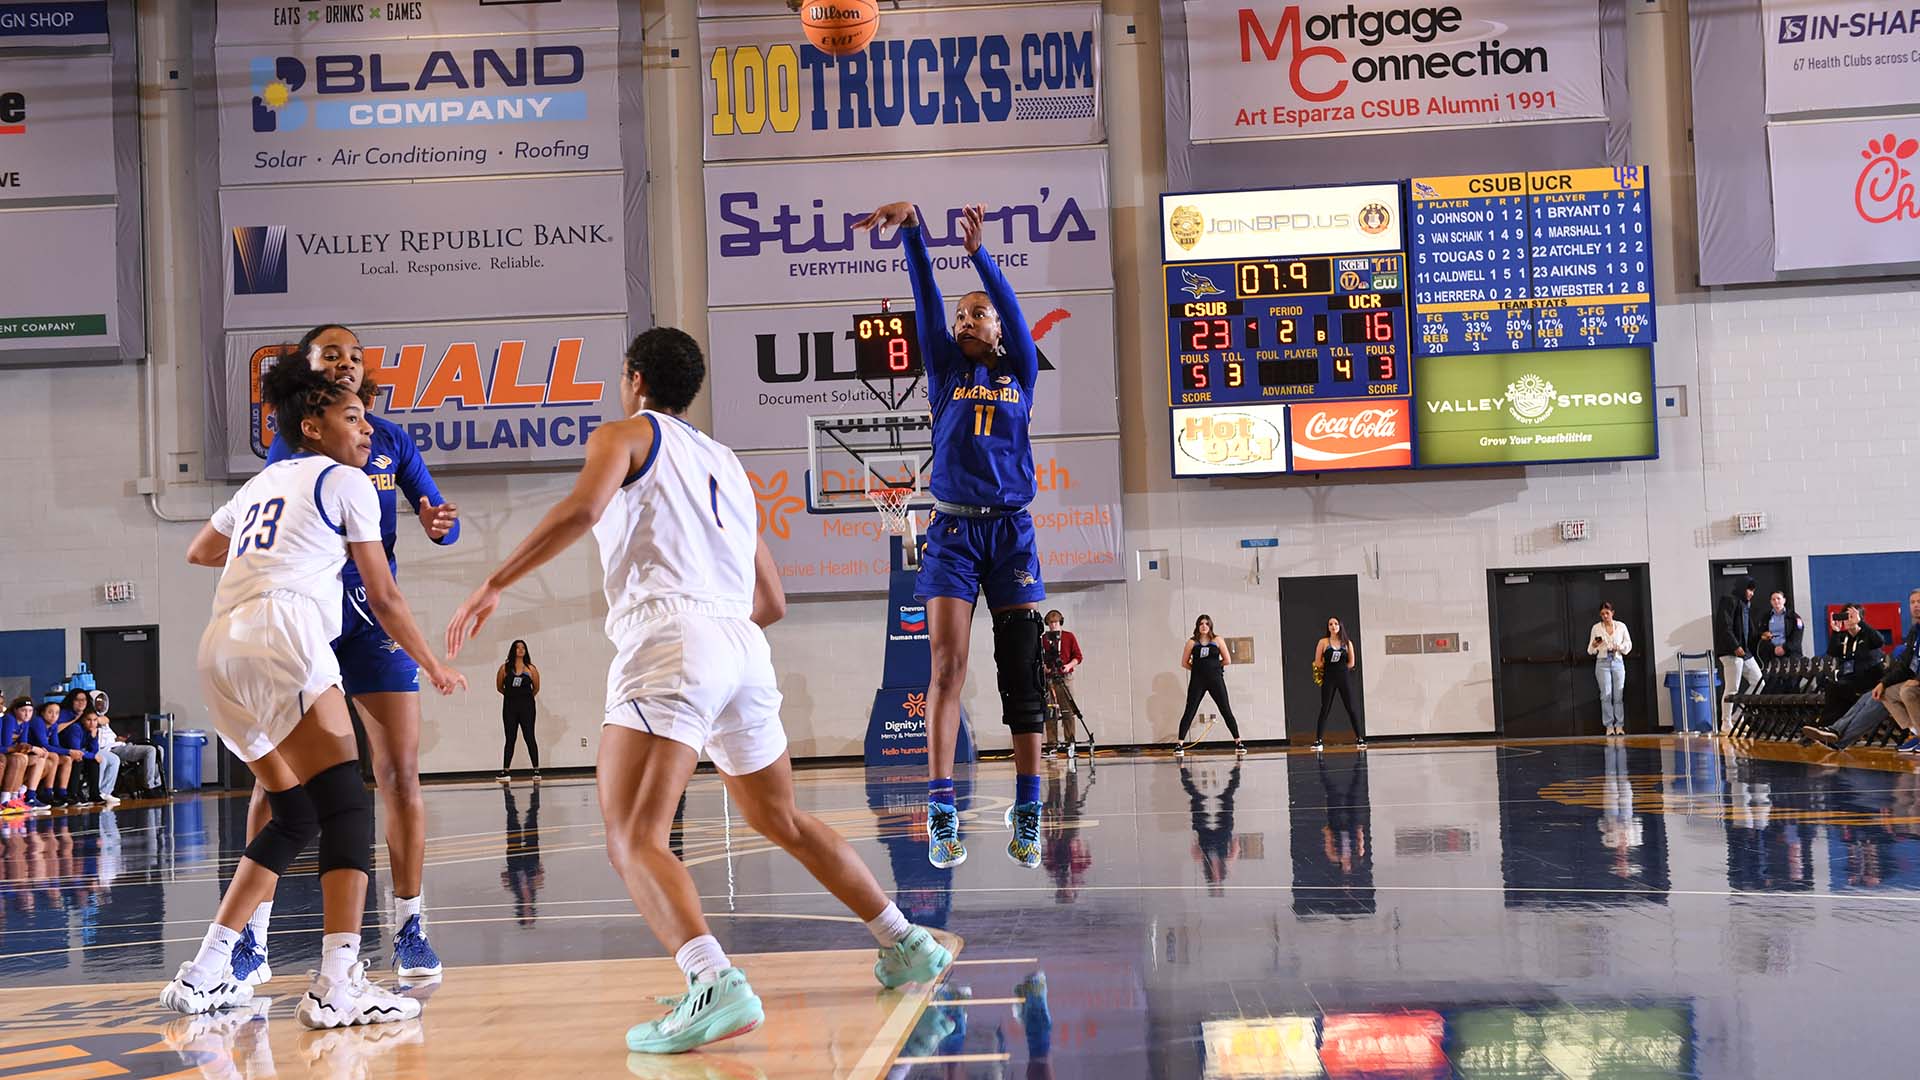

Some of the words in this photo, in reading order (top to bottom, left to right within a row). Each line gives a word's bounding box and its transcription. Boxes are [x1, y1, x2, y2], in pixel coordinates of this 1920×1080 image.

[30, 12, 74, 27] SHOP
[274, 7, 300, 26] EATS
[325, 4, 364, 24] DRINKS
[387, 2, 422, 21] GAMES
[811, 5, 860, 20] Wilson
[1811, 9, 1920, 40] IN-SHAP
[1793, 57, 1805, 71] 67
[1808, 56, 1840, 70] Health
[1844, 54, 1872, 67] Clubs
[1875, 53, 1909, 66] across
[316, 46, 585, 94] BLAND
[350, 97, 552, 126] COMPANY
[1235, 108, 1267, 126] Art
[1273, 106, 1355, 128] Esparza
[1361, 98, 1420, 118] CSUB
[1427, 94, 1499, 115] Alumni
[1506, 91, 1556, 110] 1991
[254, 150, 307, 168] Solar
[332, 149, 361, 166] Air
[365, 145, 487, 165] Conditioning
[514, 140, 590, 161] Roofing
[1469, 177, 1521, 193] CSUB
[1532, 175, 1572, 191] UCR
[1429, 200, 1469, 209] PLAYER
[1545, 194, 1586, 203] PLAYER
[1417, 214, 1424, 225] 0
[1430, 210, 1484, 225] JOHNSON
[1486, 210, 1494, 221] 0
[1502, 209, 1508, 221] 1
[1515, 209, 1523, 220] 2
[1535, 208, 1542, 219] 1
[1547, 205, 1600, 219] BRYANT
[1602, 204, 1610, 215] 0
[1617, 203, 1624, 214] 7
[1633, 202, 1641, 213] 4
[1417, 233, 1425, 244] 3
[1431, 232, 1448, 244] VAN
[1450, 230, 1483, 243] SCHAIK
[1488, 229, 1494, 240] 1
[1501, 229, 1509, 240] 4
[1515, 228, 1523, 239] 9
[1534, 227, 1542, 238] 4
[1548, 224, 1602, 238] MARSHALL
[297, 233, 390, 255] VALLEY
[400, 227, 523, 253] REPUBLIC
[1418, 253, 1426, 264] 5
[1432, 249, 1484, 263] TOUGAS
[1532, 246, 1547, 257] 22
[1549, 243, 1601, 257] ATCHLEY
[361, 261, 398, 275] Local.
[407, 259, 481, 276] Responsive.
[490, 256, 544, 270] Reliable.
[789, 259, 887, 277] EVERYTHING
[1533, 266, 1548, 278] 23
[1550, 264, 1597, 277] AIKINS
[1242, 262, 1307, 294] 07.9
[1417, 272, 1430, 283] 11
[1433, 269, 1485, 283] CALDWELL
[1417, 292, 1431, 303] 13
[1434, 289, 1485, 303] HERRERA
[1534, 286, 1549, 297] 32
[1551, 283, 1604, 296] WEBSTER
[1607, 282, 1614, 293] 1
[1621, 282, 1629, 293] 2
[1637, 281, 1645, 292] 8
[1349, 294, 1382, 309] UCR
[1498, 301, 1528, 309] TEAM
[1532, 299, 1568, 308] STATS
[1184, 302, 1227, 317] CSUB
[1269, 306, 1303, 316] PERIOD
[21, 322, 76, 332] COMPANY
[1365, 312, 1392, 341] 16
[1466, 321, 1492, 333] 33%
[1506, 319, 1532, 331] 50%
[1537, 318, 1563, 330] 17%
[1581, 316, 1607, 328] 15%
[1615, 314, 1648, 326] 100%
[859, 318, 902, 338] 07.9
[1192, 319, 1231, 350] 23
[1279, 319, 1294, 343] 2
[1423, 323, 1448, 335] 32%
[1472, 341, 1480, 351] 3
[1511, 340, 1519, 350] 6
[1543, 337, 1558, 348] 23
[1588, 336, 1595, 346] 3
[1627, 334, 1635, 344] 7
[888, 338, 908, 370] 8
[1256, 350, 1279, 360] FOUL
[1284, 348, 1318, 359] PLAYER
[1366, 344, 1395, 355] FOULS
[1429, 343, 1443, 353] 20
[1180, 353, 1210, 364] FOULS
[1228, 363, 1242, 387] 3
[1336, 359, 1351, 380] 4
[1380, 356, 1393, 379] 3
[1192, 365, 1207, 388] 5
[1262, 385, 1315, 396] ADVANTAGE
[1368, 384, 1398, 395] SCORE
[759, 390, 827, 406] Document
[1182, 392, 1212, 403] SCORE
[1426, 398, 1505, 413] VALLEY
[1558, 391, 1643, 407] STRONG
[974, 404, 995, 436] 11
[1305, 408, 1398, 440] Coca-Cola
[1184, 416, 1255, 440] Hot
[1480, 436, 1507, 446] Grow
[1509, 435, 1533, 445] Your
[1535, 432, 1592, 444] Possibilities
[1033, 503, 1112, 533] ospitals
[236, 496, 286, 558] 23
[885, 720, 917, 732] Dignity
